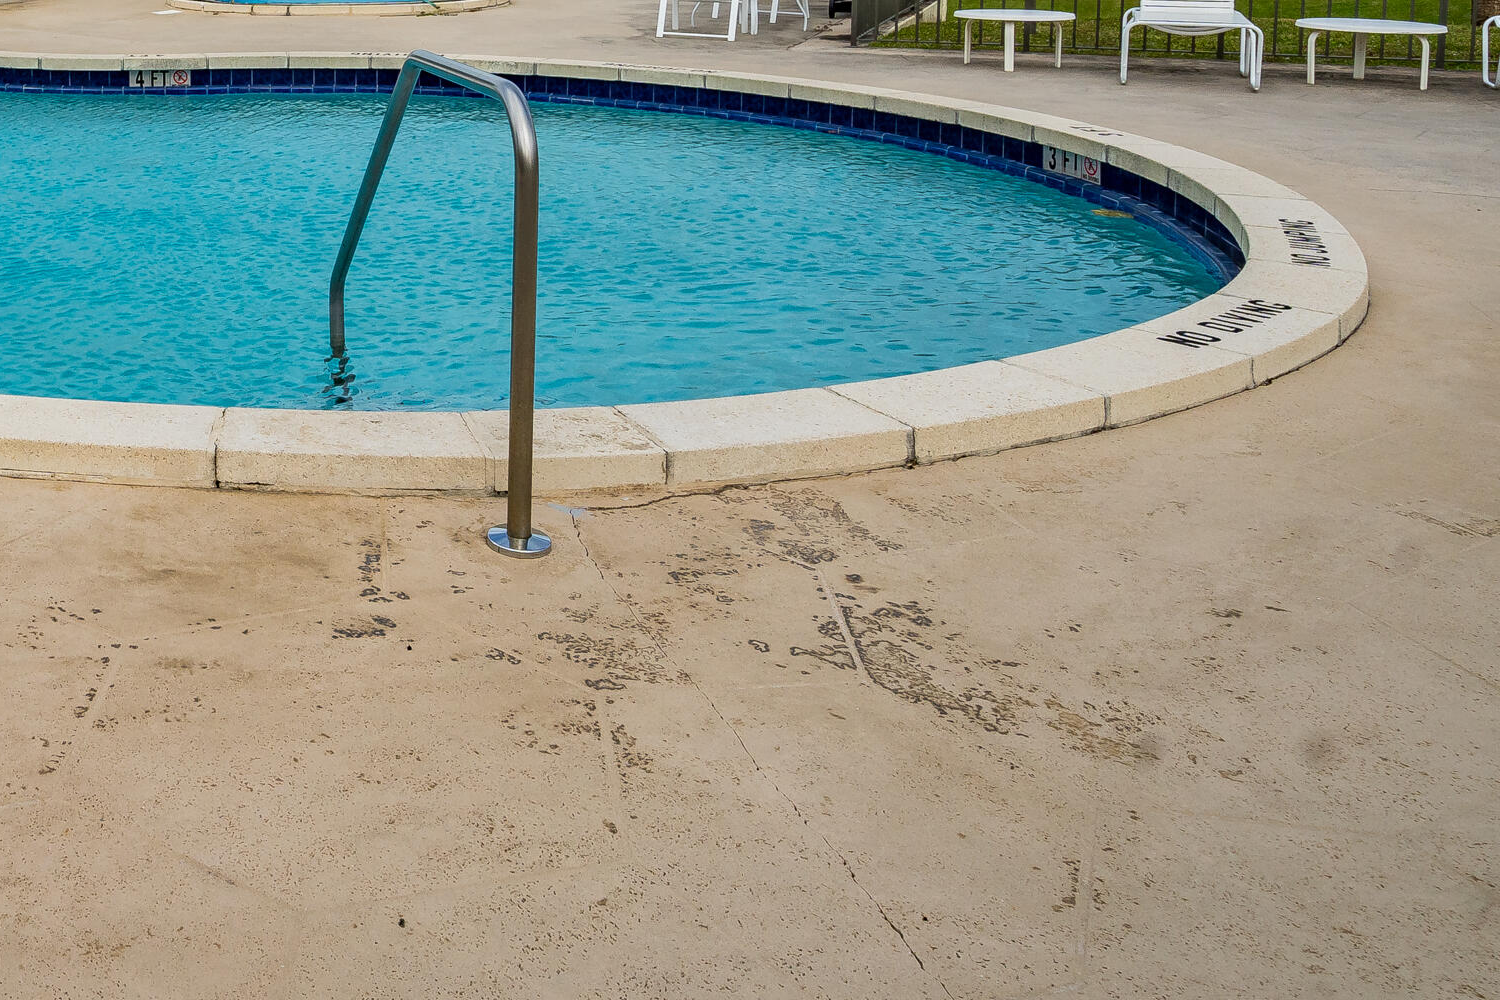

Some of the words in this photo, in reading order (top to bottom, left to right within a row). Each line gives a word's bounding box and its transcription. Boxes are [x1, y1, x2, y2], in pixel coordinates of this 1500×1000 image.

[136, 70, 144, 87] 4
[151, 70, 169, 86] FT
[1049, 147, 1056, 170] 3
[1156, 330, 1222, 348] NO
[1197, 299, 1293, 334] DIVING
